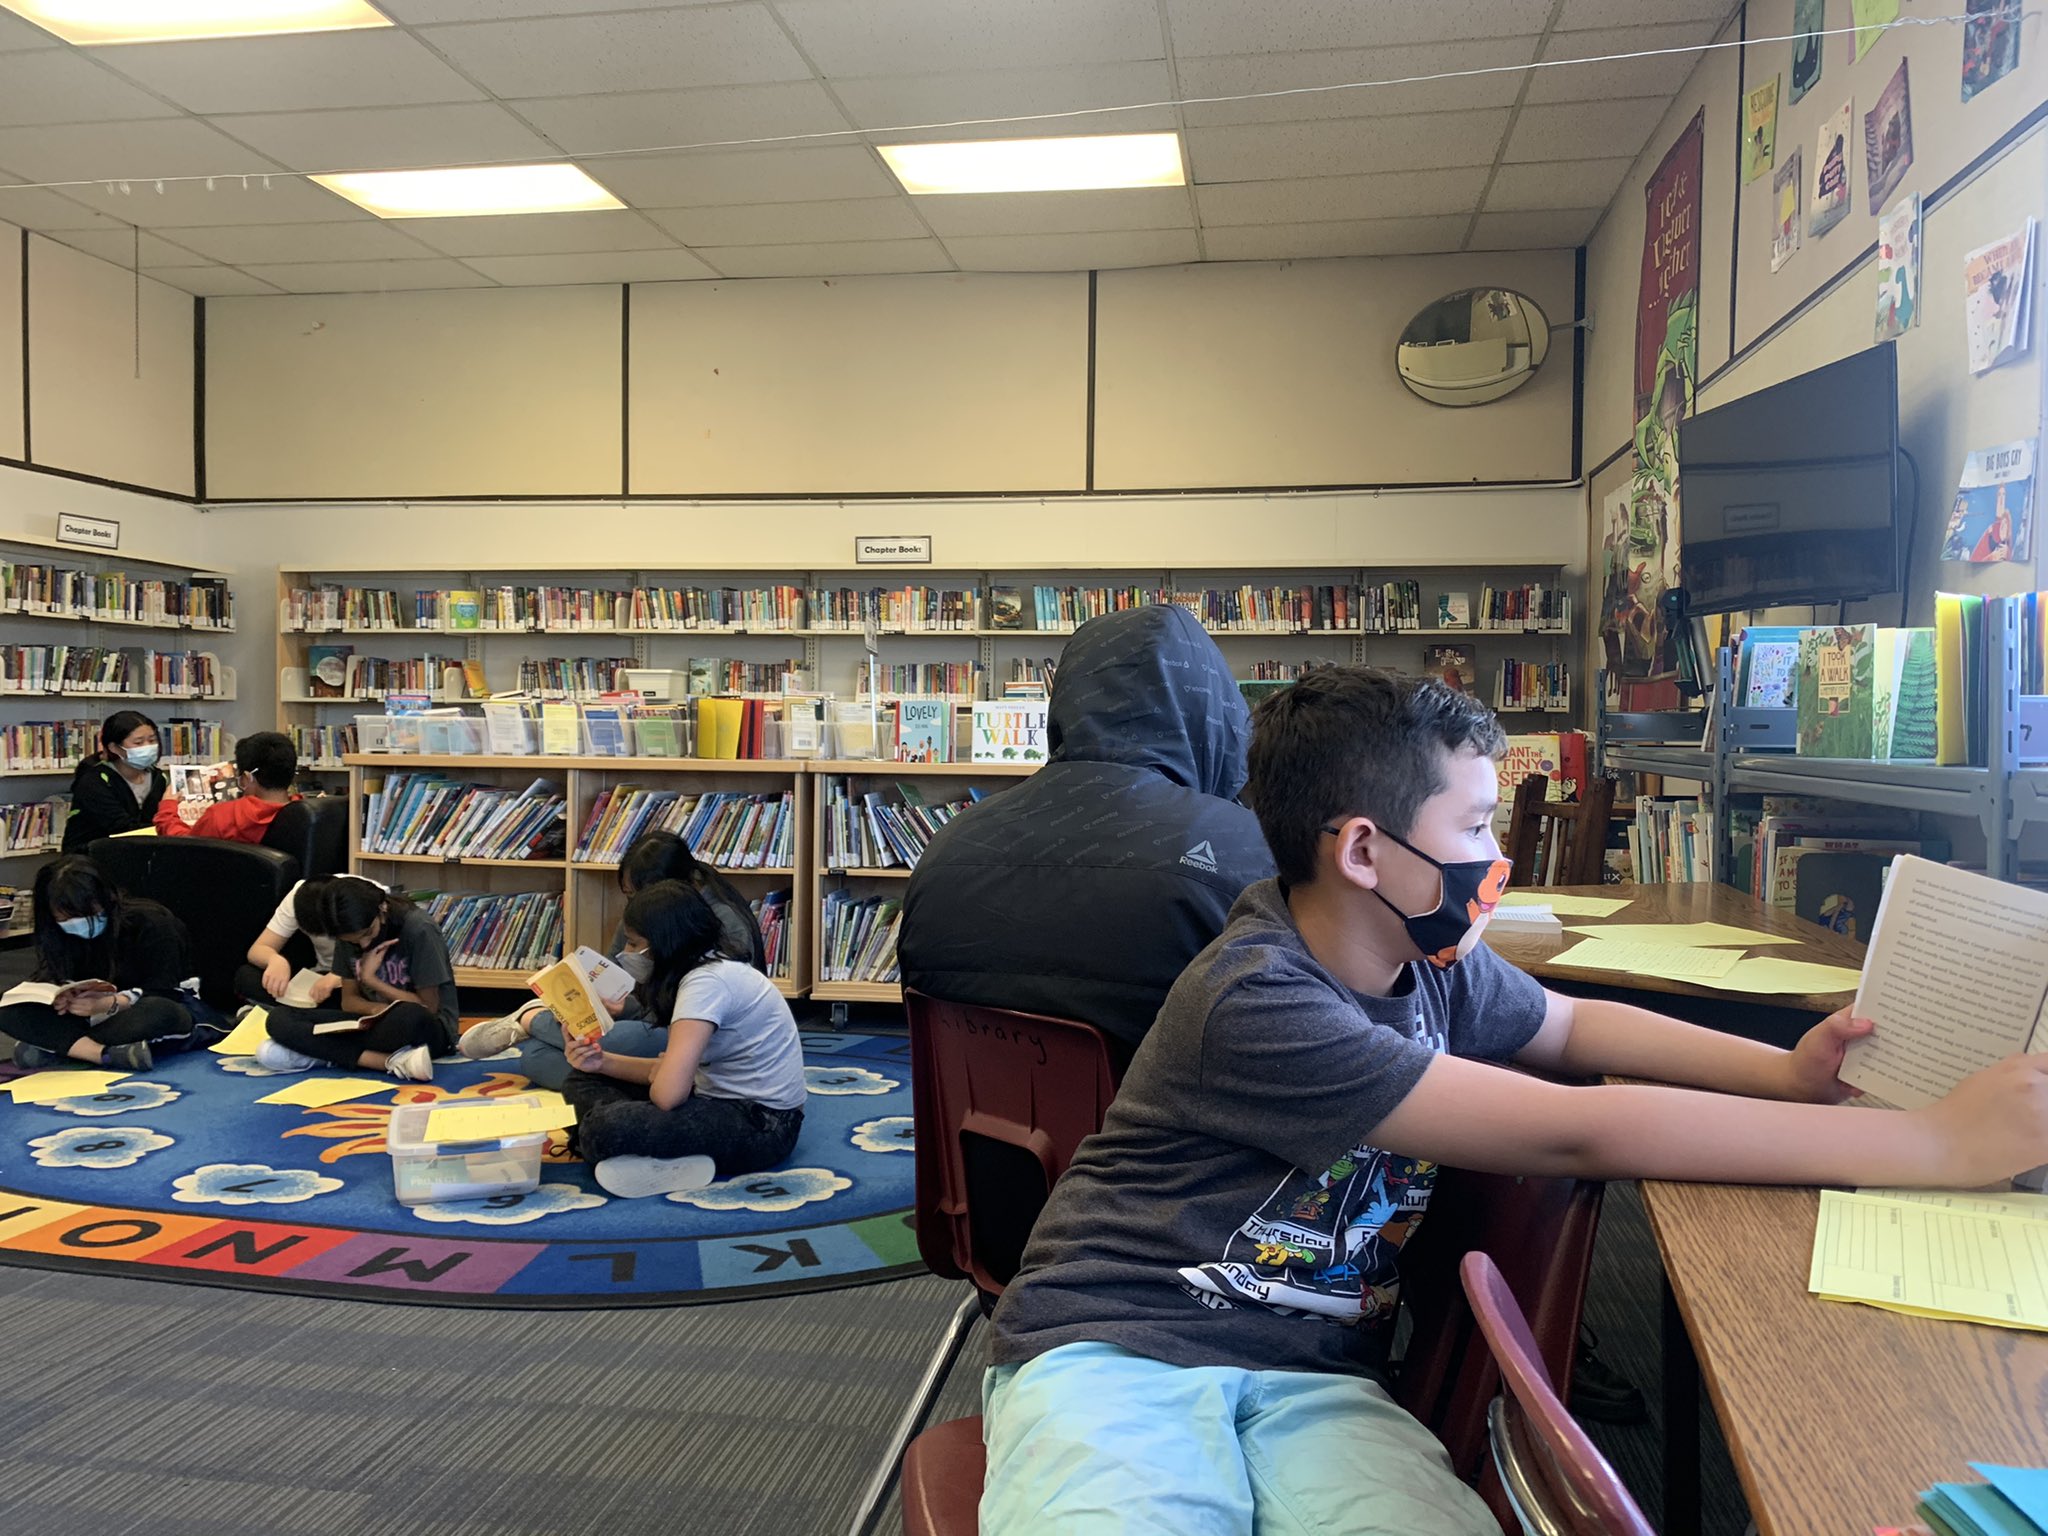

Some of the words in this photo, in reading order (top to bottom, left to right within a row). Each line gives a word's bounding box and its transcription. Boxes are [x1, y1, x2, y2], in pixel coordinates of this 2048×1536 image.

[1985, 455, 1995, 472] BIG
[1996, 451, 2010, 470] BOYS
[2011, 449, 2022, 466] CRY
[64, 524, 92, 536] Chapter
[92, 528, 112, 539] Books
[864, 546, 897, 554] Chapter
[898, 545, 922, 553] Books
[1822, 652, 1827, 666] I
[1827, 651, 1847, 666] TOOK
[1820, 667, 1827, 682] A
[1827, 666, 1849, 682] WALK
[904, 704, 938, 721] LOVELY
[974, 712, 1046, 729] TURTLE
[982, 729, 1038, 746] WALK
[1503, 758, 1543, 770] TINY
[1824, 841, 1859, 849] WHAT
[1179, 855, 1219, 874] Reebok
[1778, 855, 1788, 866] IF
[1778, 881, 1790, 892] TO
[74, 1139, 126, 1154] 8
[221, 1178, 279, 1193] 7
[745, 1181, 791, 1198] 5
[58, 1218, 162, 1248] O
[1246, 1220, 1330, 1249] Thursday
[182, 1230, 308, 1265] N
[730, 1238, 822, 1273] K
[345, 1247, 472, 1283] M
[568, 1251, 636, 1282] L
